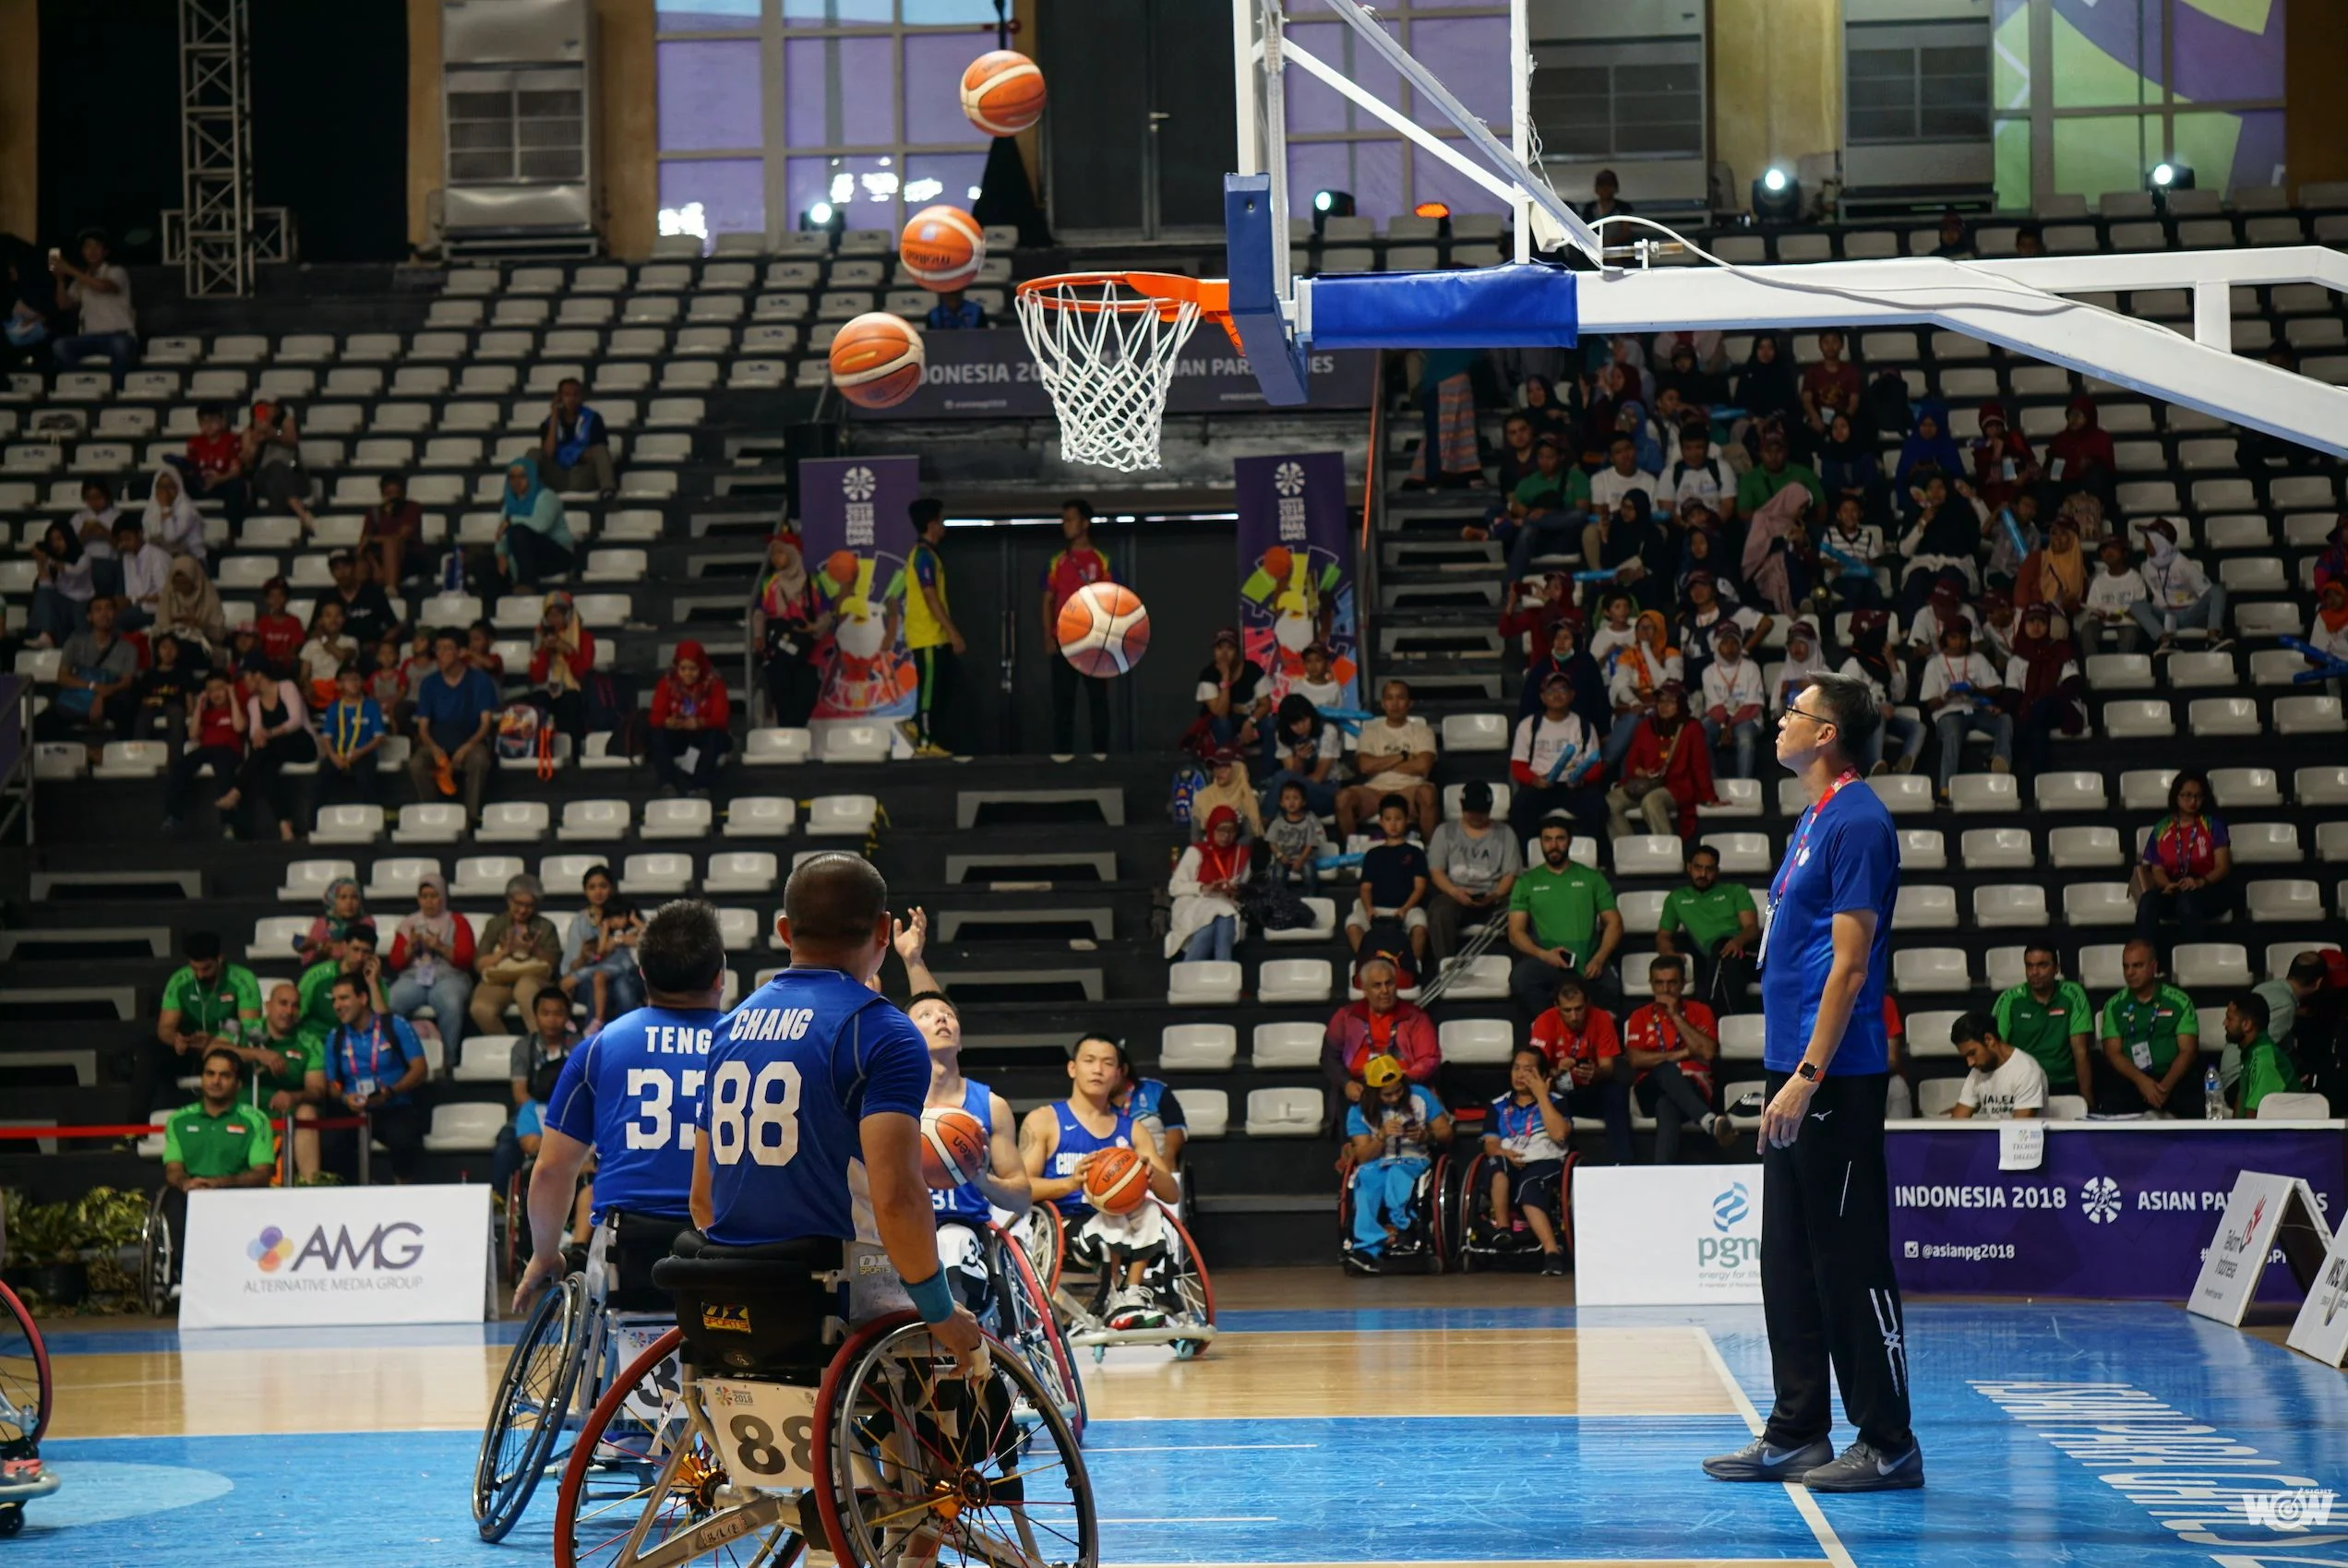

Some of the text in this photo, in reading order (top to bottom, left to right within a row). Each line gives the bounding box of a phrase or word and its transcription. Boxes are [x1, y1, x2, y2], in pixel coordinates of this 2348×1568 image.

[919, 364, 1010, 385] DONESIA
[728, 1008, 814, 1041] CHANG
[645, 1025, 713, 1055] TENG
[711, 1060, 802, 1167] 88
[1895, 1185, 2233, 1212] INDONESIA 2018 ASIAN PA
[290, 1221, 425, 1272] AMG
[1697, 1237, 1761, 1268] pgn
[1922, 1242, 2016, 1262] @asianpg2018
[858, 1265, 893, 1275] SPORTS
[244, 1275, 425, 1293] ALTERNATIVE MEDIA GROUP
[734, 1394, 754, 1404] 2018
